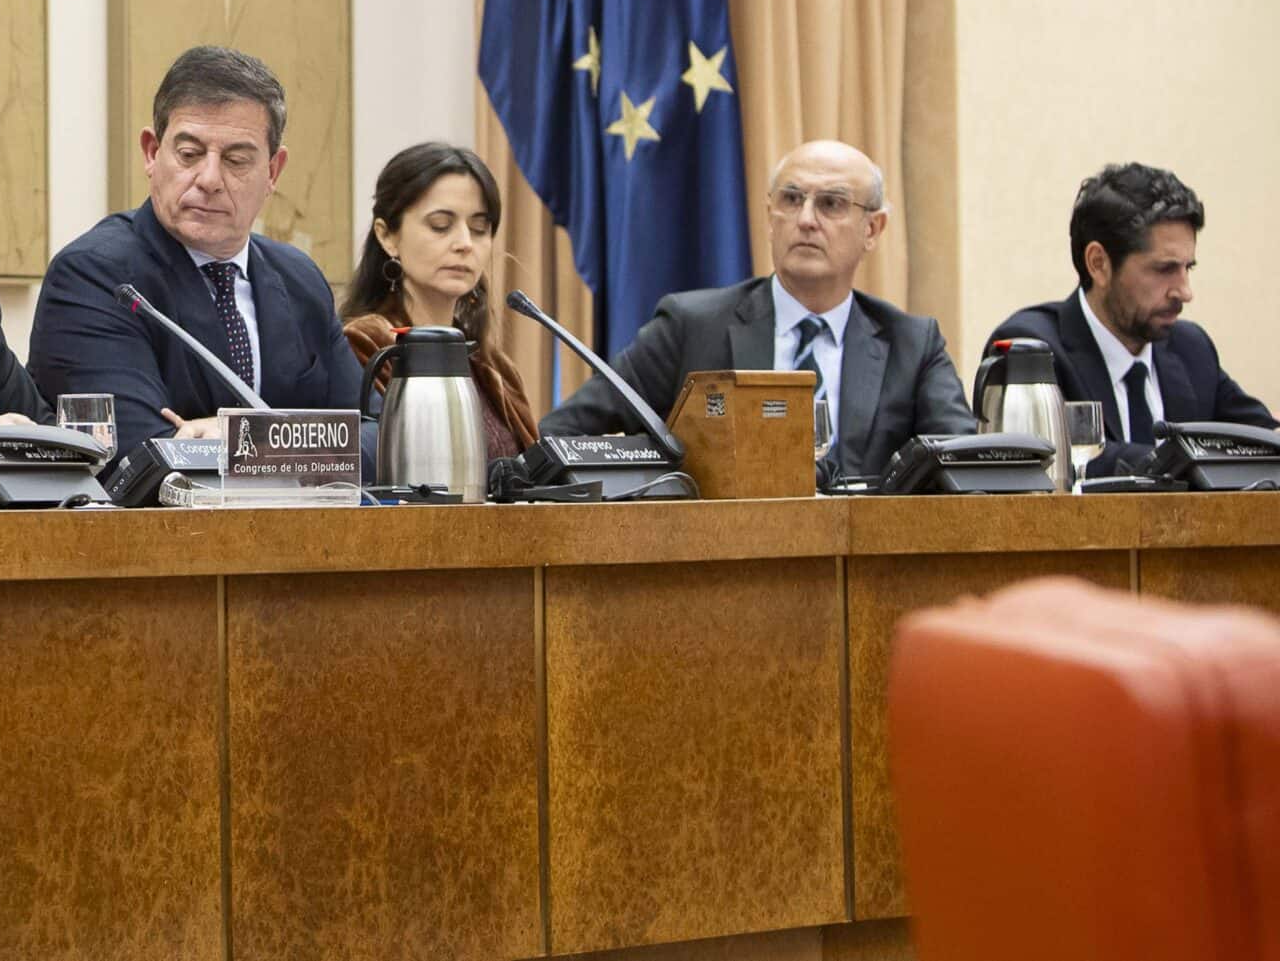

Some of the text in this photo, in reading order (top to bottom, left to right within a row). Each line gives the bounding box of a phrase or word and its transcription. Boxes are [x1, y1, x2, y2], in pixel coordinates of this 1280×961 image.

[268, 423, 349, 449] GOBIERNO
[234, 462, 355, 475] Congreso de los Diputados
